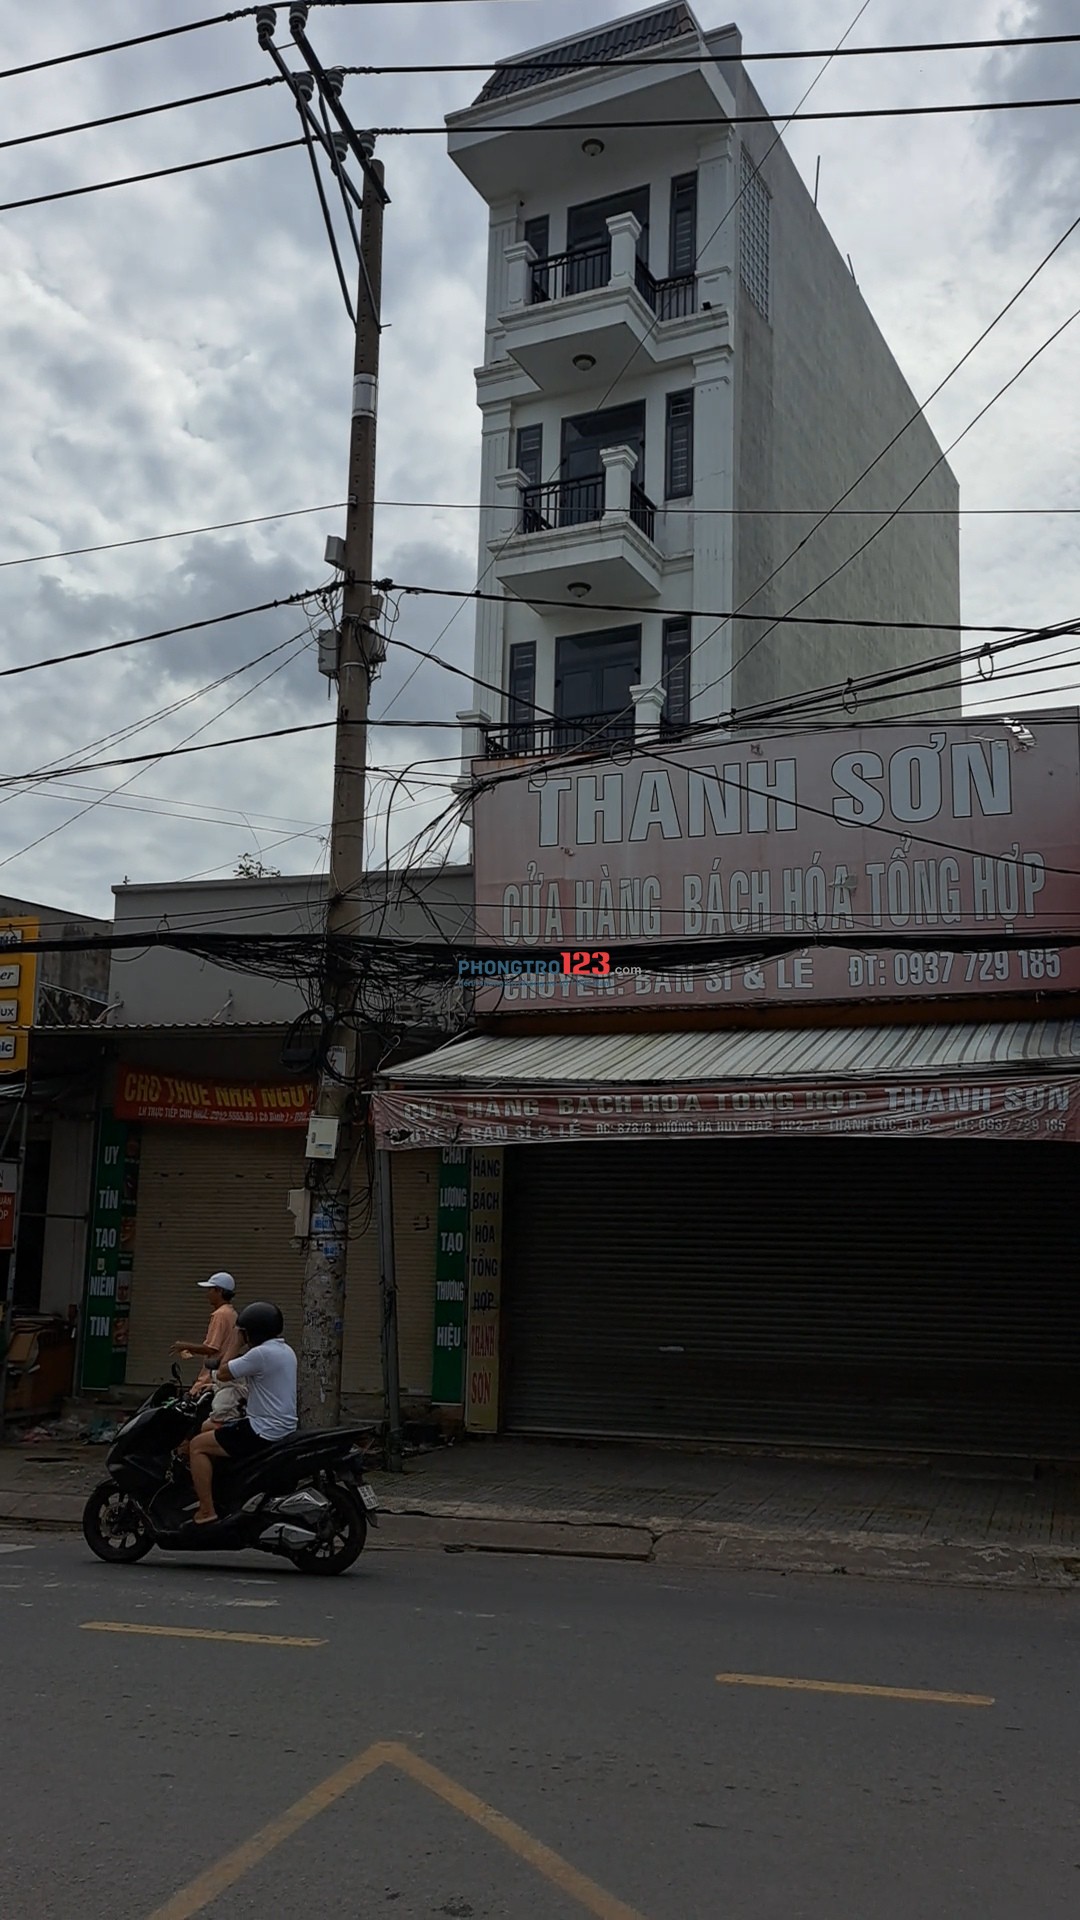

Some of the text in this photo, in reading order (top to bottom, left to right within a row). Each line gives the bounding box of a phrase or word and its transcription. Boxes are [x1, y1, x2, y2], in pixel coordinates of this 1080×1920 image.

[528, 732, 1012, 847] THANH SƠN
[502, 830, 1046, 947] CỬA HÀNG BÁCH HÓA TỔNG HỢP
[743, 961, 767, 990] &
[848, 955, 886, 986] ĐT:
[893, 951, 955, 985] 0937
[963, 950, 1009, 982] 729
[1017, 949, 1061, 979] 185
[124, 1072, 162, 1103] CHO
[884, 1086, 992, 1112] THANH
[104, 1145, 120, 1165] UY
[98, 1185, 119, 1209] TÍN
[95, 1228, 117, 1252] TẠO
[440, 1232, 464, 1256] TẠO
[89, 1316, 110, 1337] TIN
